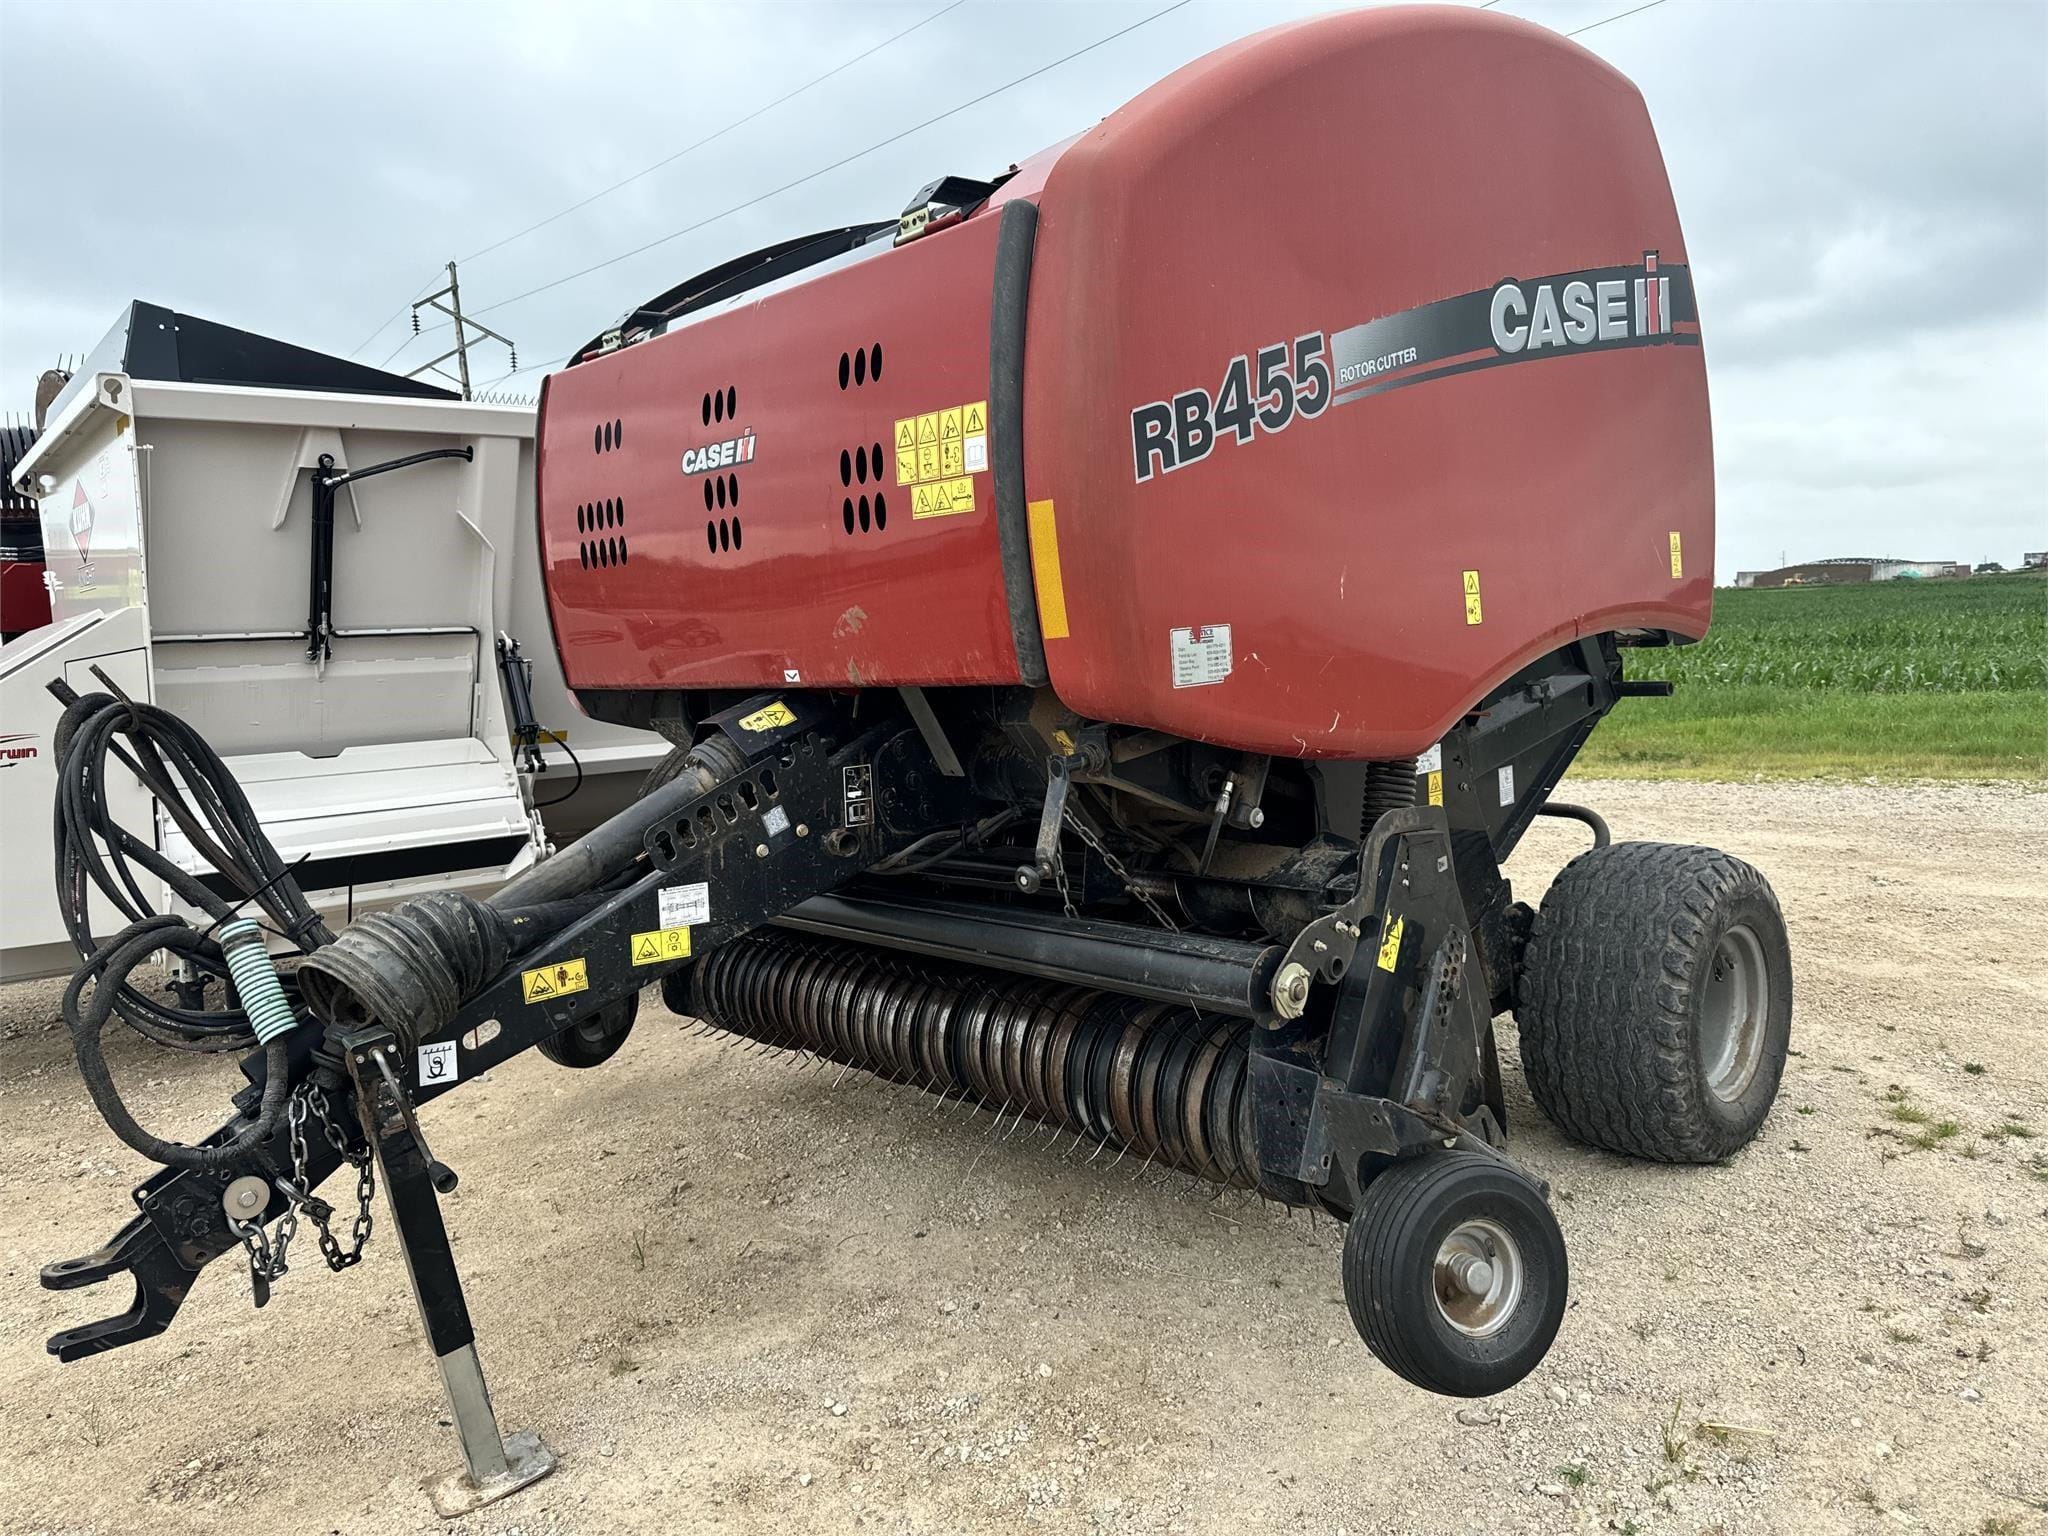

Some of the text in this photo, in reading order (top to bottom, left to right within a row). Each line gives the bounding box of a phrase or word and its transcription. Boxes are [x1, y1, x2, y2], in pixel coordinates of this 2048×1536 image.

[1490, 279, 1629, 354] CASE
[1340, 347, 1417, 383] ROTOR CUTTER
[1131, 331, 1331, 483] RB455
[682, 441, 735, 474] CASE
